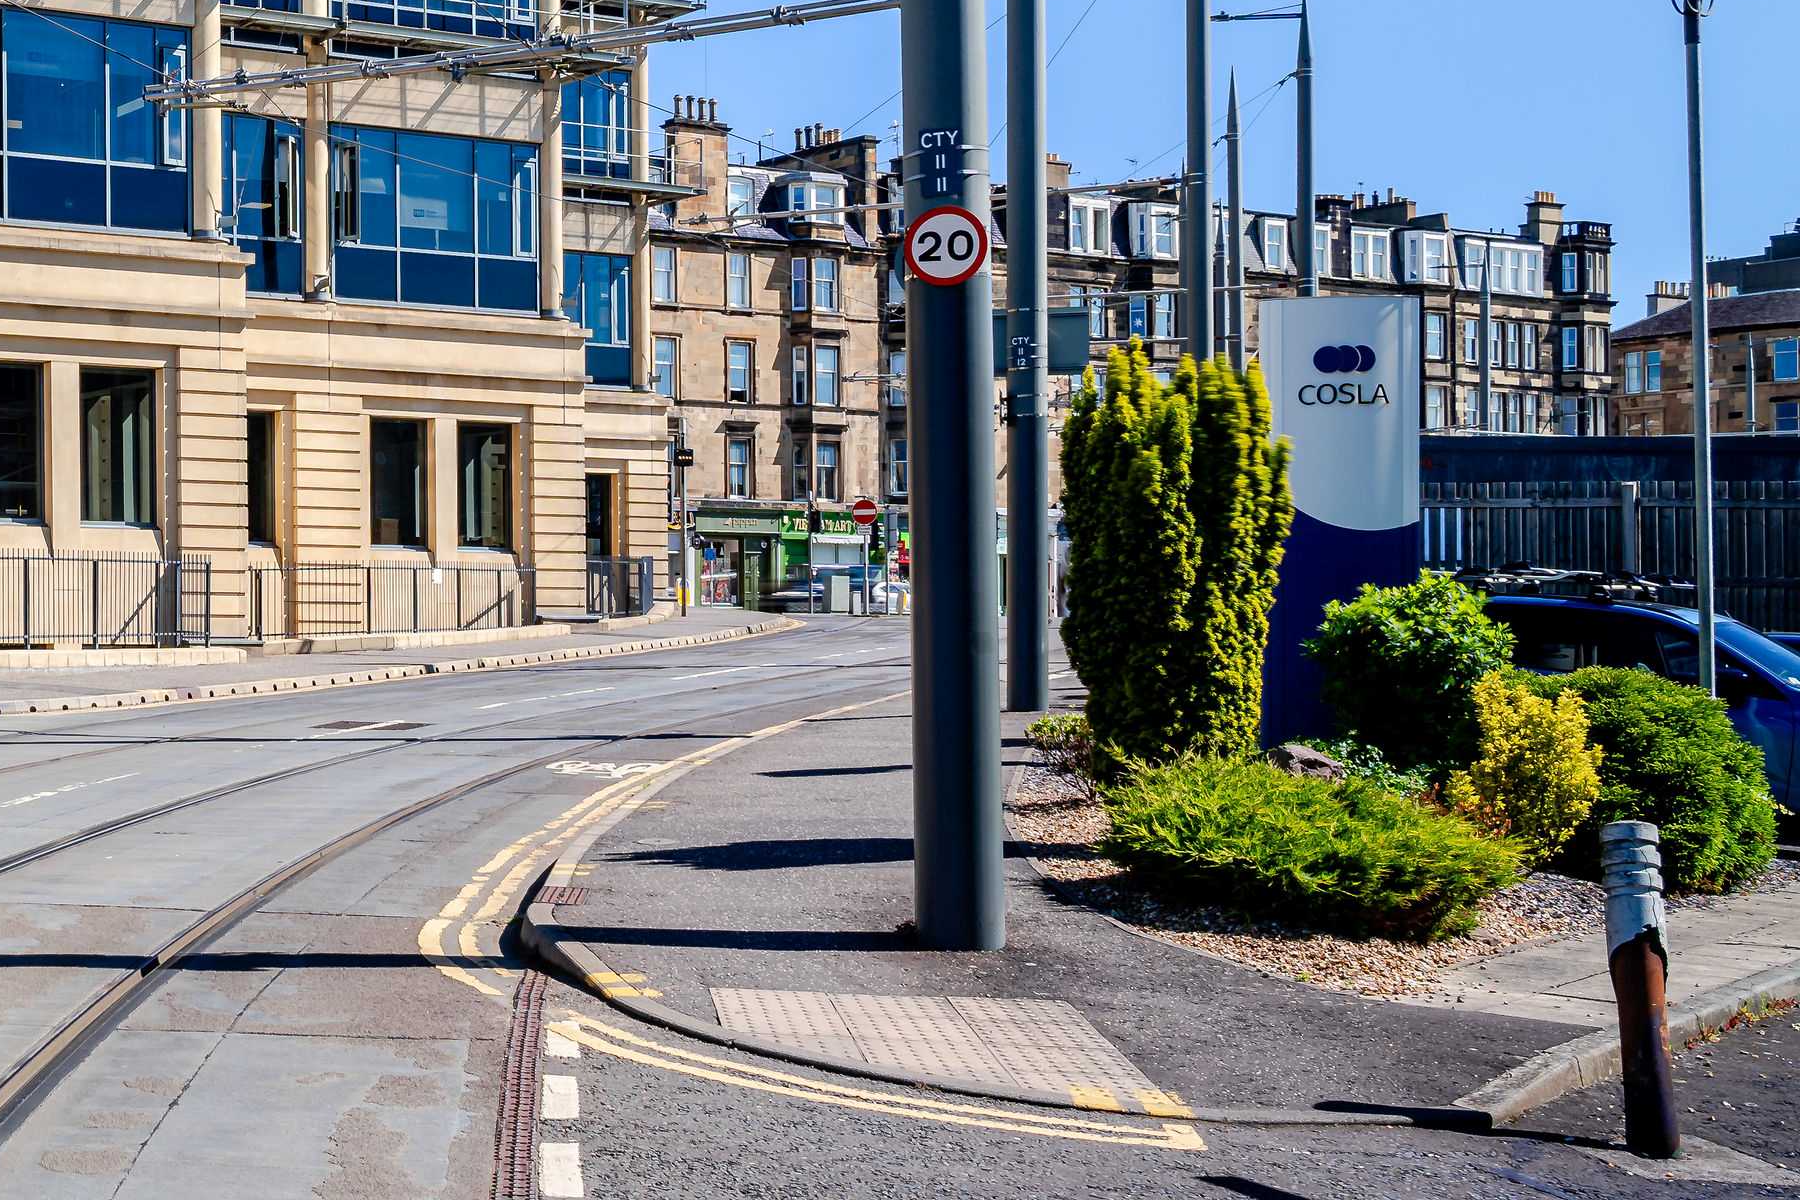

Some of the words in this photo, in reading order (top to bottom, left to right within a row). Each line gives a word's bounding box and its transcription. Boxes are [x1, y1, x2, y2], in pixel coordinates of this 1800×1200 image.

[920, 130, 959, 149] CTY
[917, 230, 974, 262] 20
[1011, 336, 1030, 345] CTY
[1017, 358, 1027, 366] 12
[1298, 383, 1390, 406] COSLA
